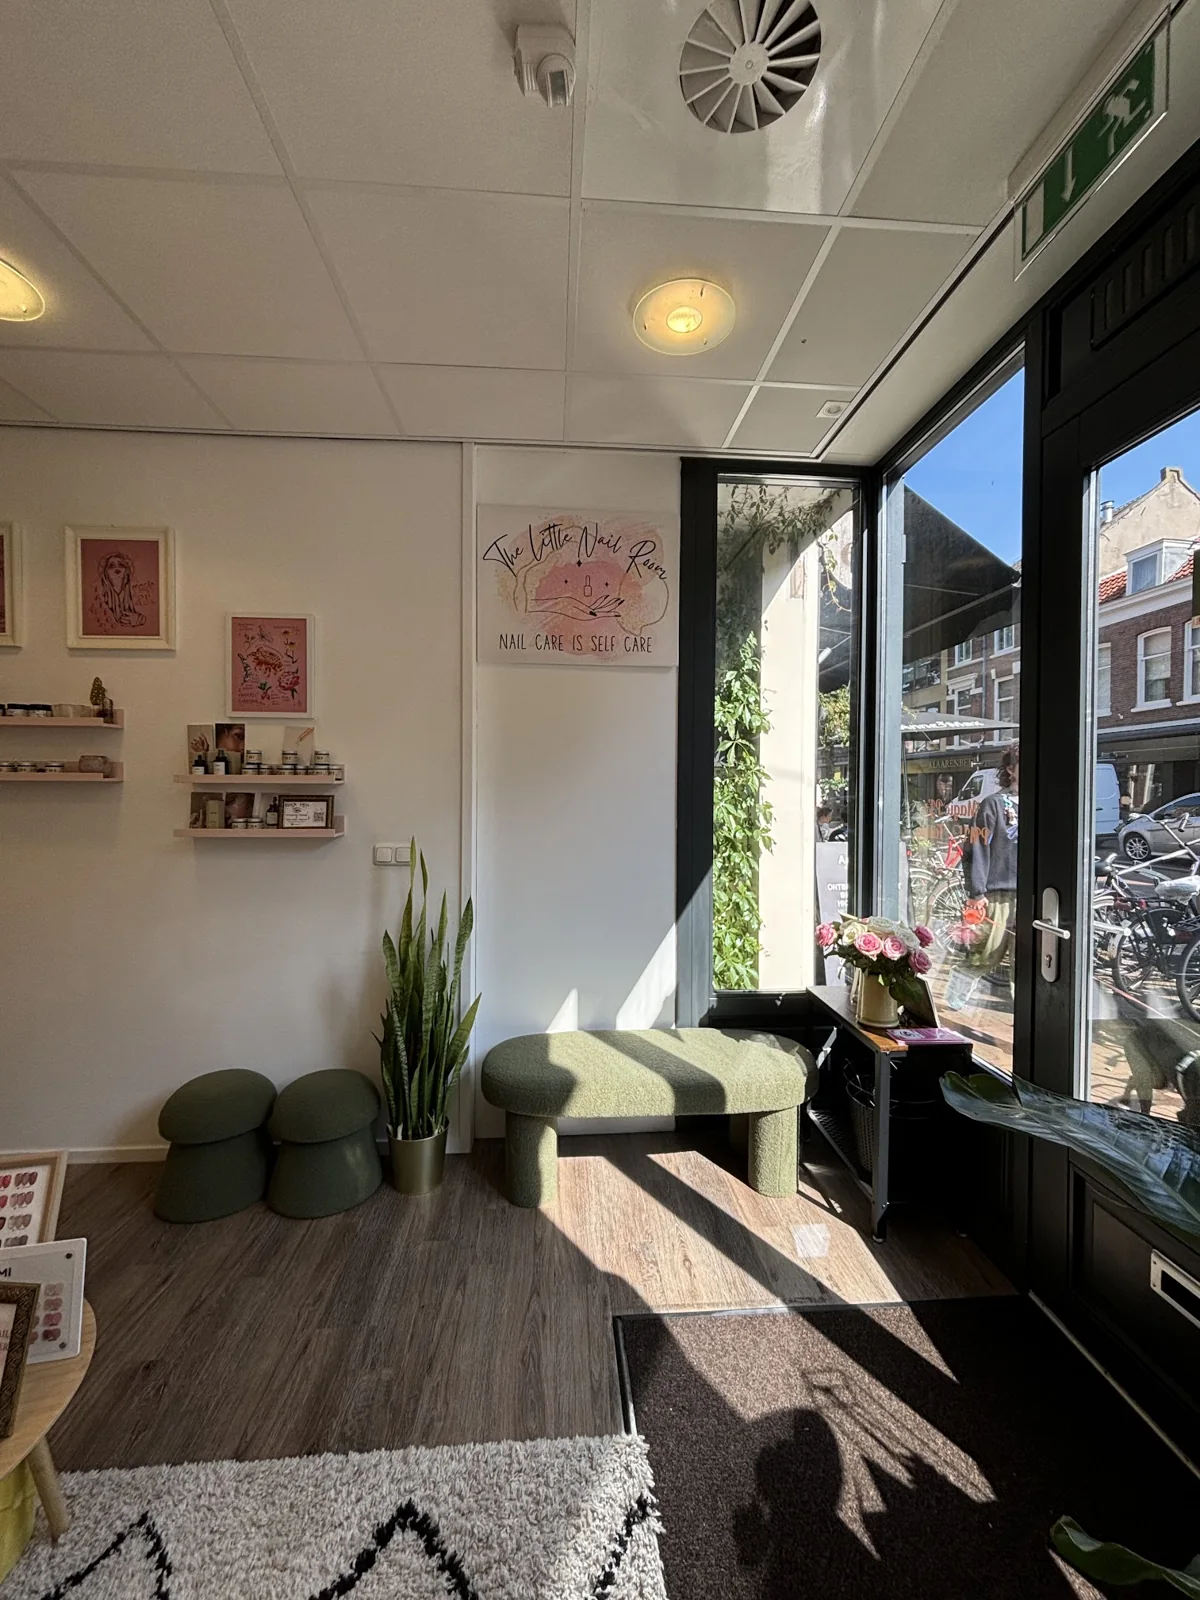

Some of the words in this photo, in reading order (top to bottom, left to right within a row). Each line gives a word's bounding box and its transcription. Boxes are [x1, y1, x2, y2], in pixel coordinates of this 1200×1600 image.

[483, 534, 524, 577] The
[529, 523, 572, 561] Little
[578, 522, 622, 558] Nail
[626, 540, 667, 580] Room
[499, 634, 527, 650] NAIL
[535, 634, 564, 651] CARE
[572, 634, 583, 651] IS
[591, 635, 615, 652] SELF
[623, 636, 653, 653] CARE
